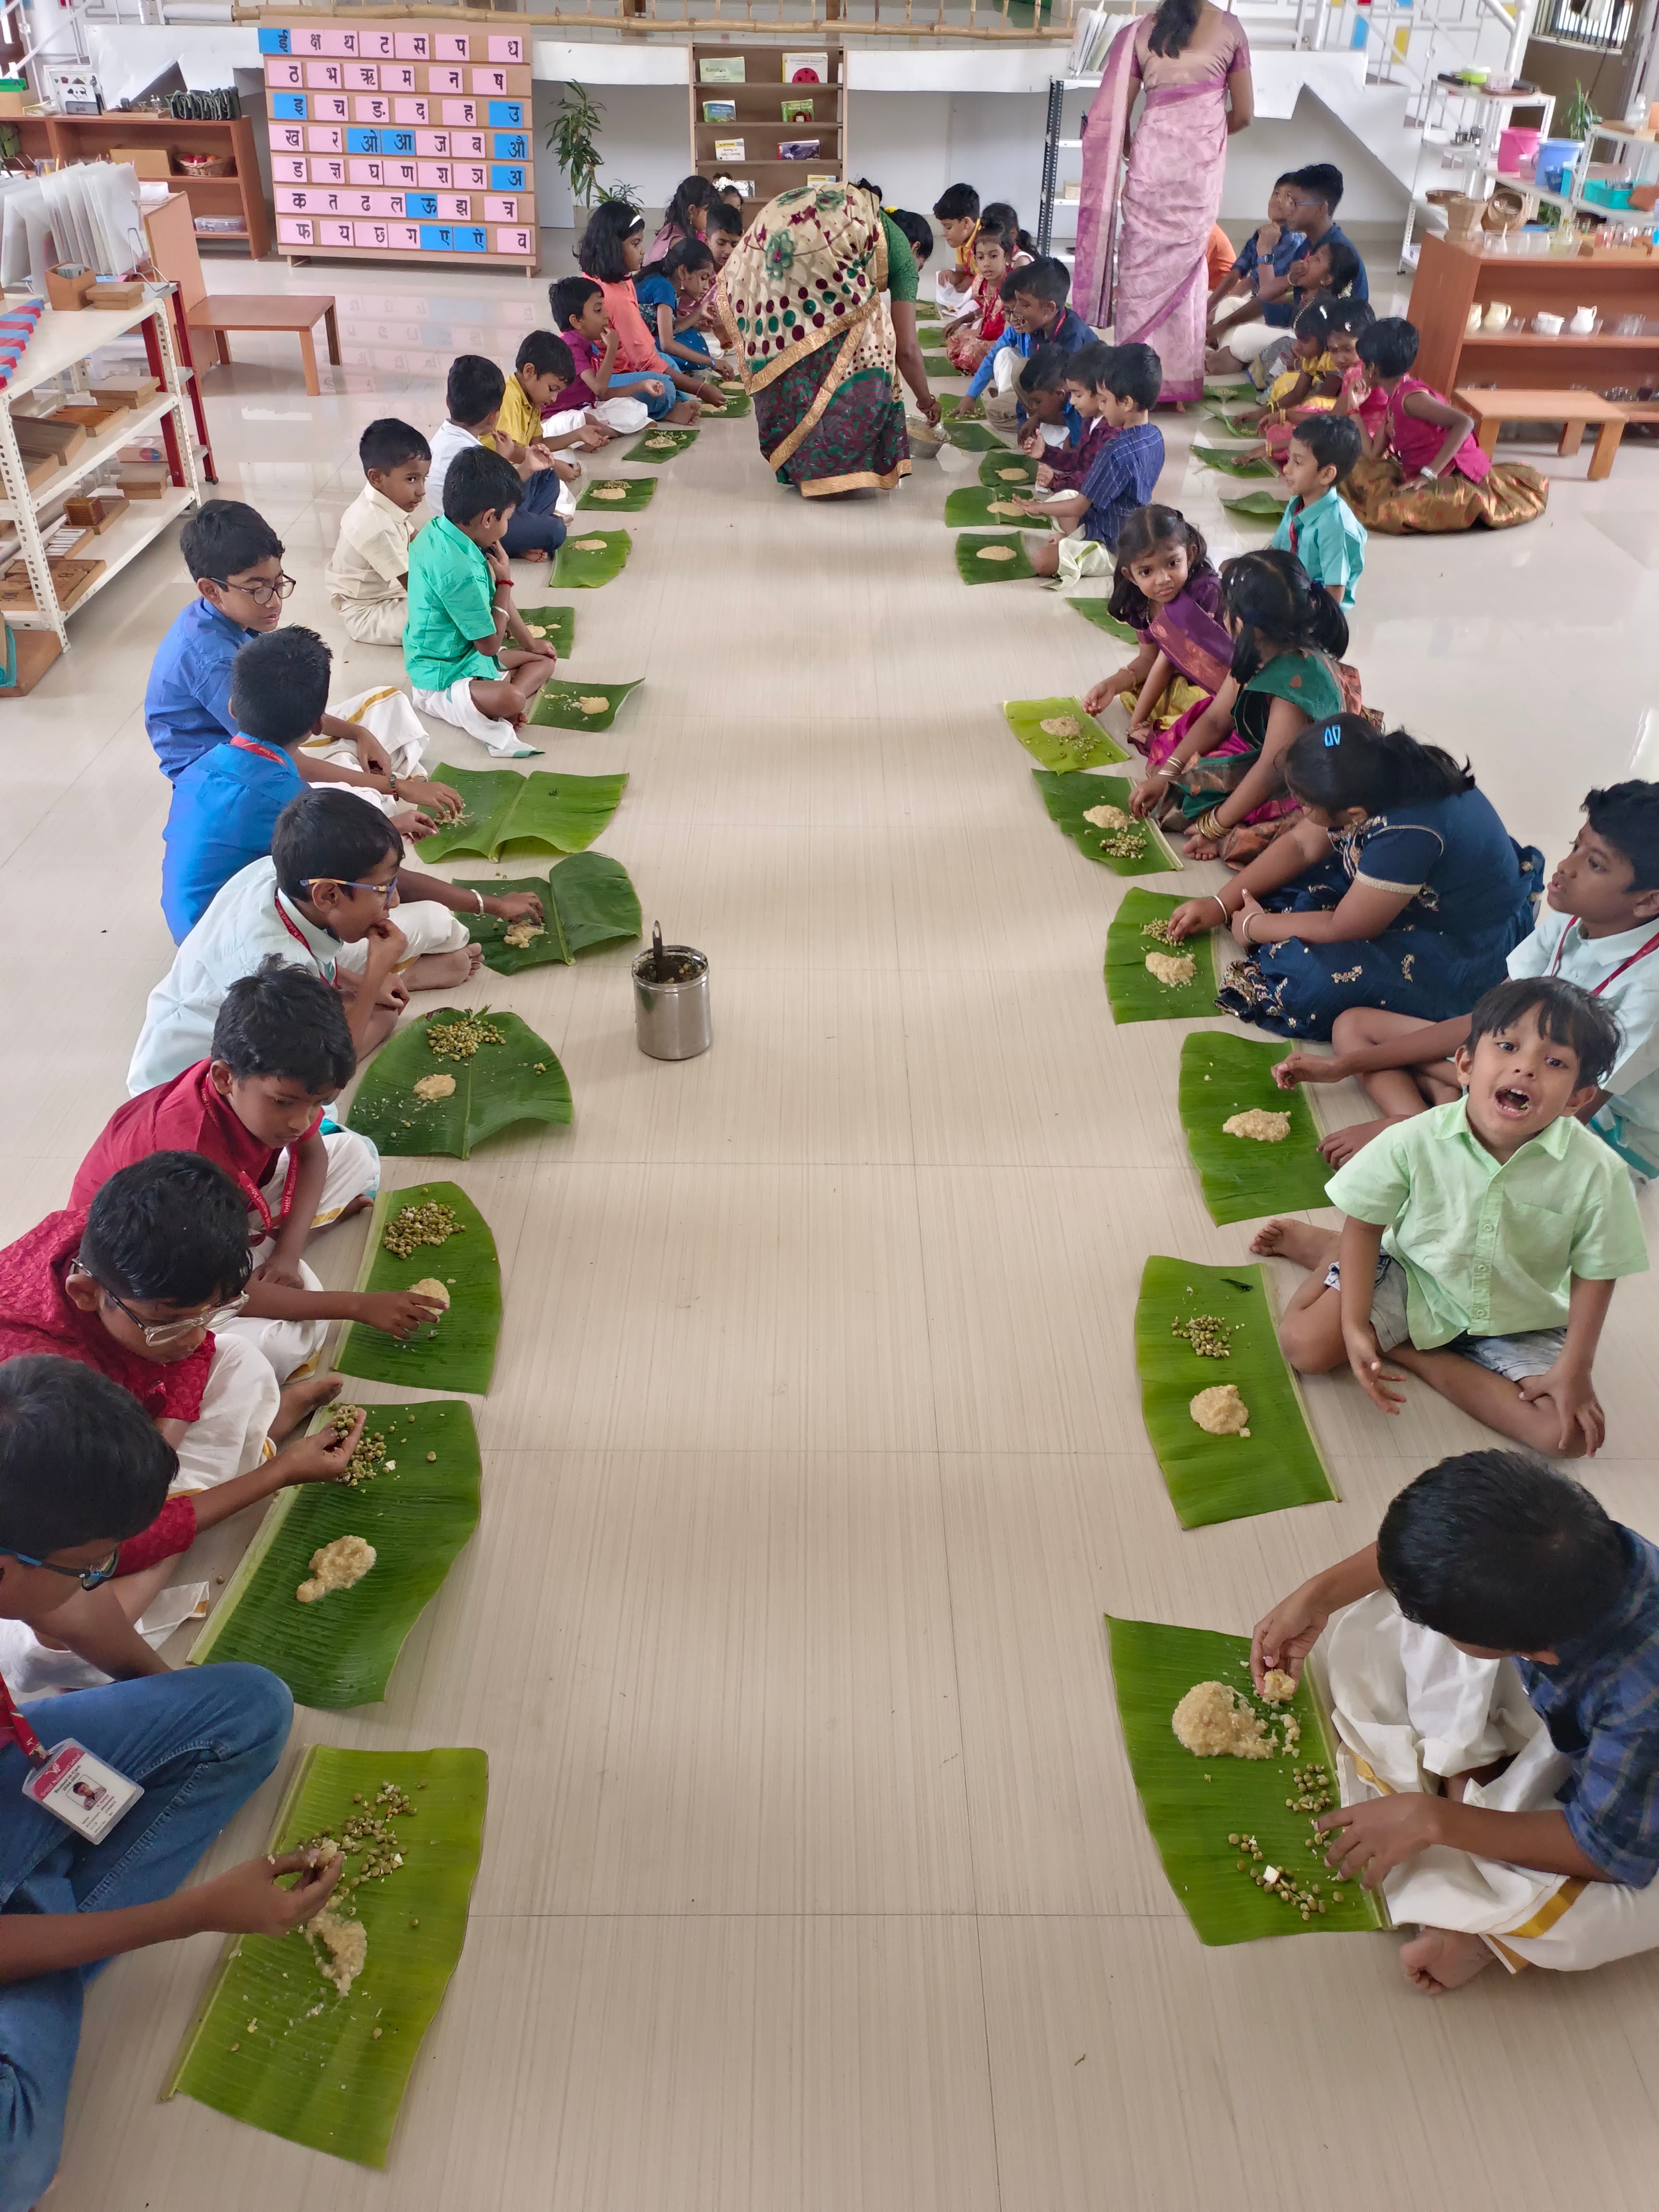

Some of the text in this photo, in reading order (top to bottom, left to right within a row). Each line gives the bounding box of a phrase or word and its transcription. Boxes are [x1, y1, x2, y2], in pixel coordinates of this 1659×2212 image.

[380, 36, 389, 54] ट
[413, 37, 426, 55] स
[455, 39, 466, 56] प
[507, 41, 518, 58] ध
[289, 66, 504, 91] ठ भ ऋ म न ष
[293, 98, 304, 116] इ
[333, 99, 345, 117] च
[415, 103, 425, 120] द
[463, 105, 473, 122] ह
[507, 106, 520, 122] उ
[285, 129, 525, 158] ख र ओ आ ज ब औ
[292, 161, 303, 178] ड
[368, 164, 380, 180] घ
[400, 166, 414, 182] ण
[436, 167, 448, 183] श
[508, 170, 523, 186] अ
[292, 192, 515, 217] क त ढ ल ऊ झ त्र
[295, 223, 527, 249] फ य छ ग ए ऐ व
